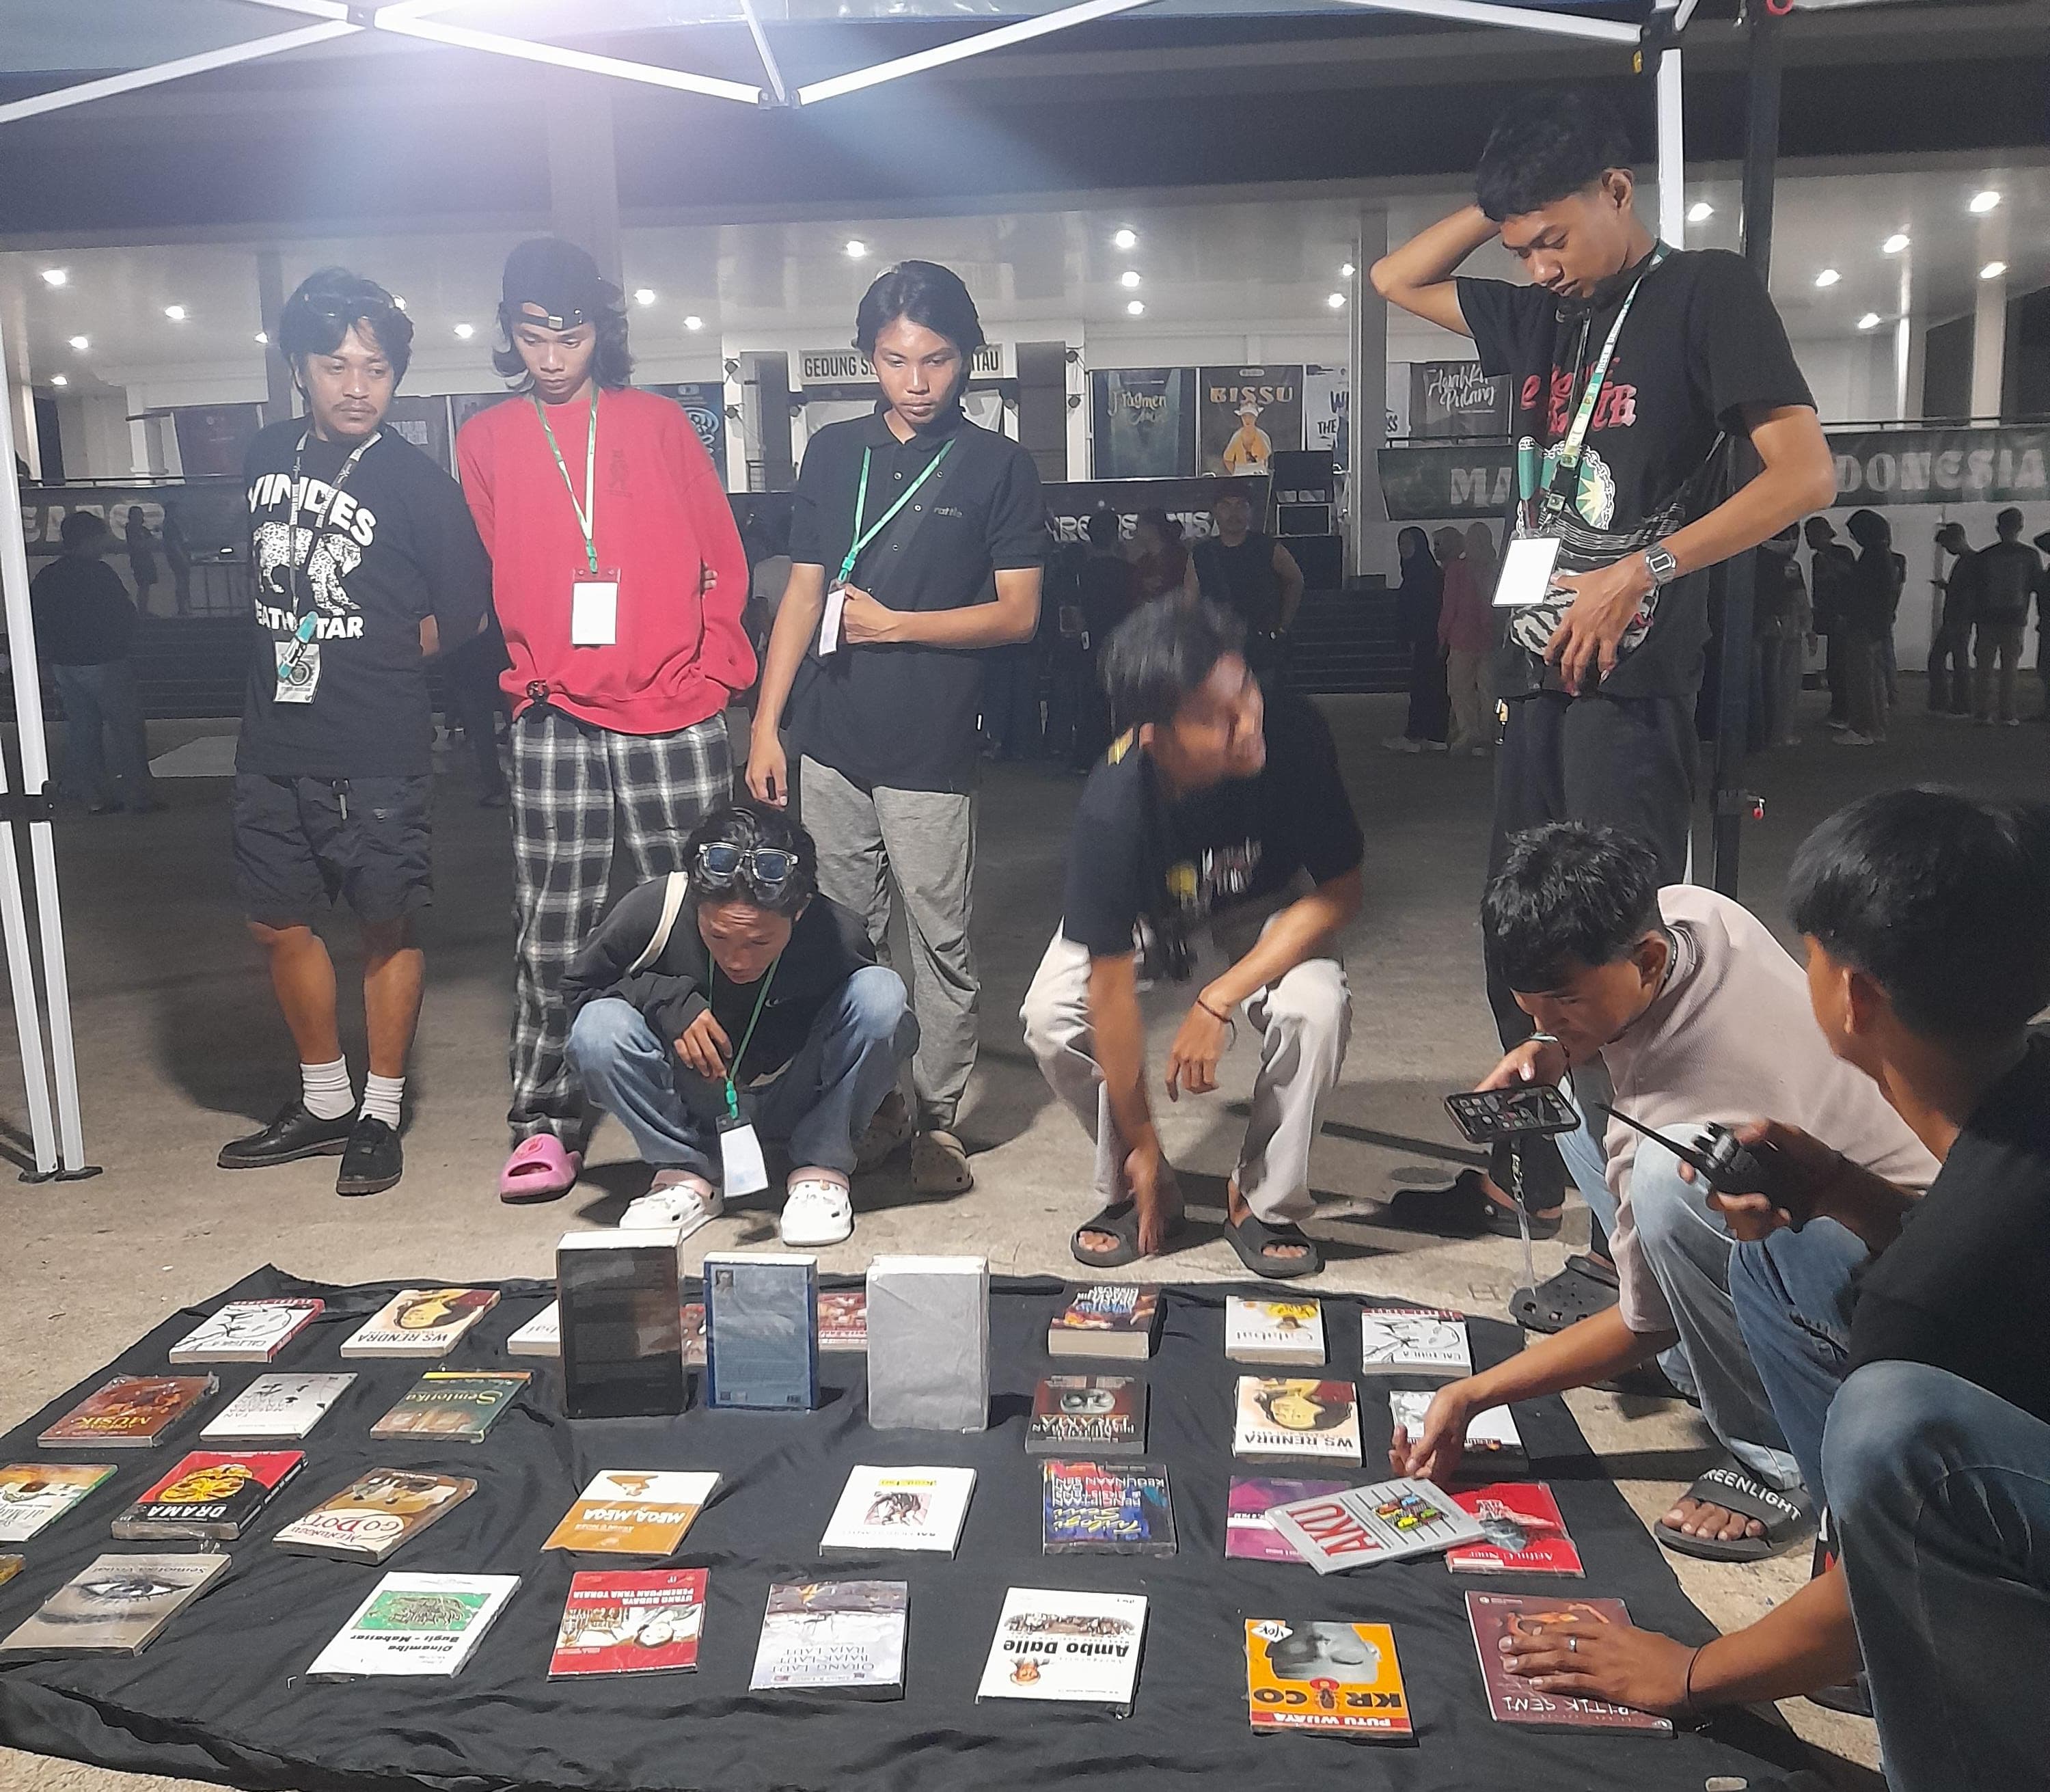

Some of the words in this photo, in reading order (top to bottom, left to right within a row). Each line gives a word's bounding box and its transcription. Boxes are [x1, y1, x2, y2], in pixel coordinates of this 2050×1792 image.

[804, 356, 857, 377] GEDUNG
[1209, 386, 1294, 405] BISSU
[357, 1333, 419, 1343] RENDRA
[422, 1333, 448, 1342] WS
[81, 1416, 153, 1426] MUSIK
[1244, 1433, 1322, 1448] RENDRA
[1328, 1435, 1354, 1449] WS
[146, 1505, 228, 1519] DRAMA
[583, 1508, 633, 1522] MEGA
[1286, 1504, 1385, 1557] AKU
[350, 1634, 413, 1643] Makassar
[387, 1644, 454, 1653] Dinamika
[1002, 1640, 1058, 1655] Dalle
[1065, 1642, 1130, 1658] Ambo
[1272, 1712, 1341, 1726] WIJAYA
[1343, 1717, 1392, 1728] PUTU
